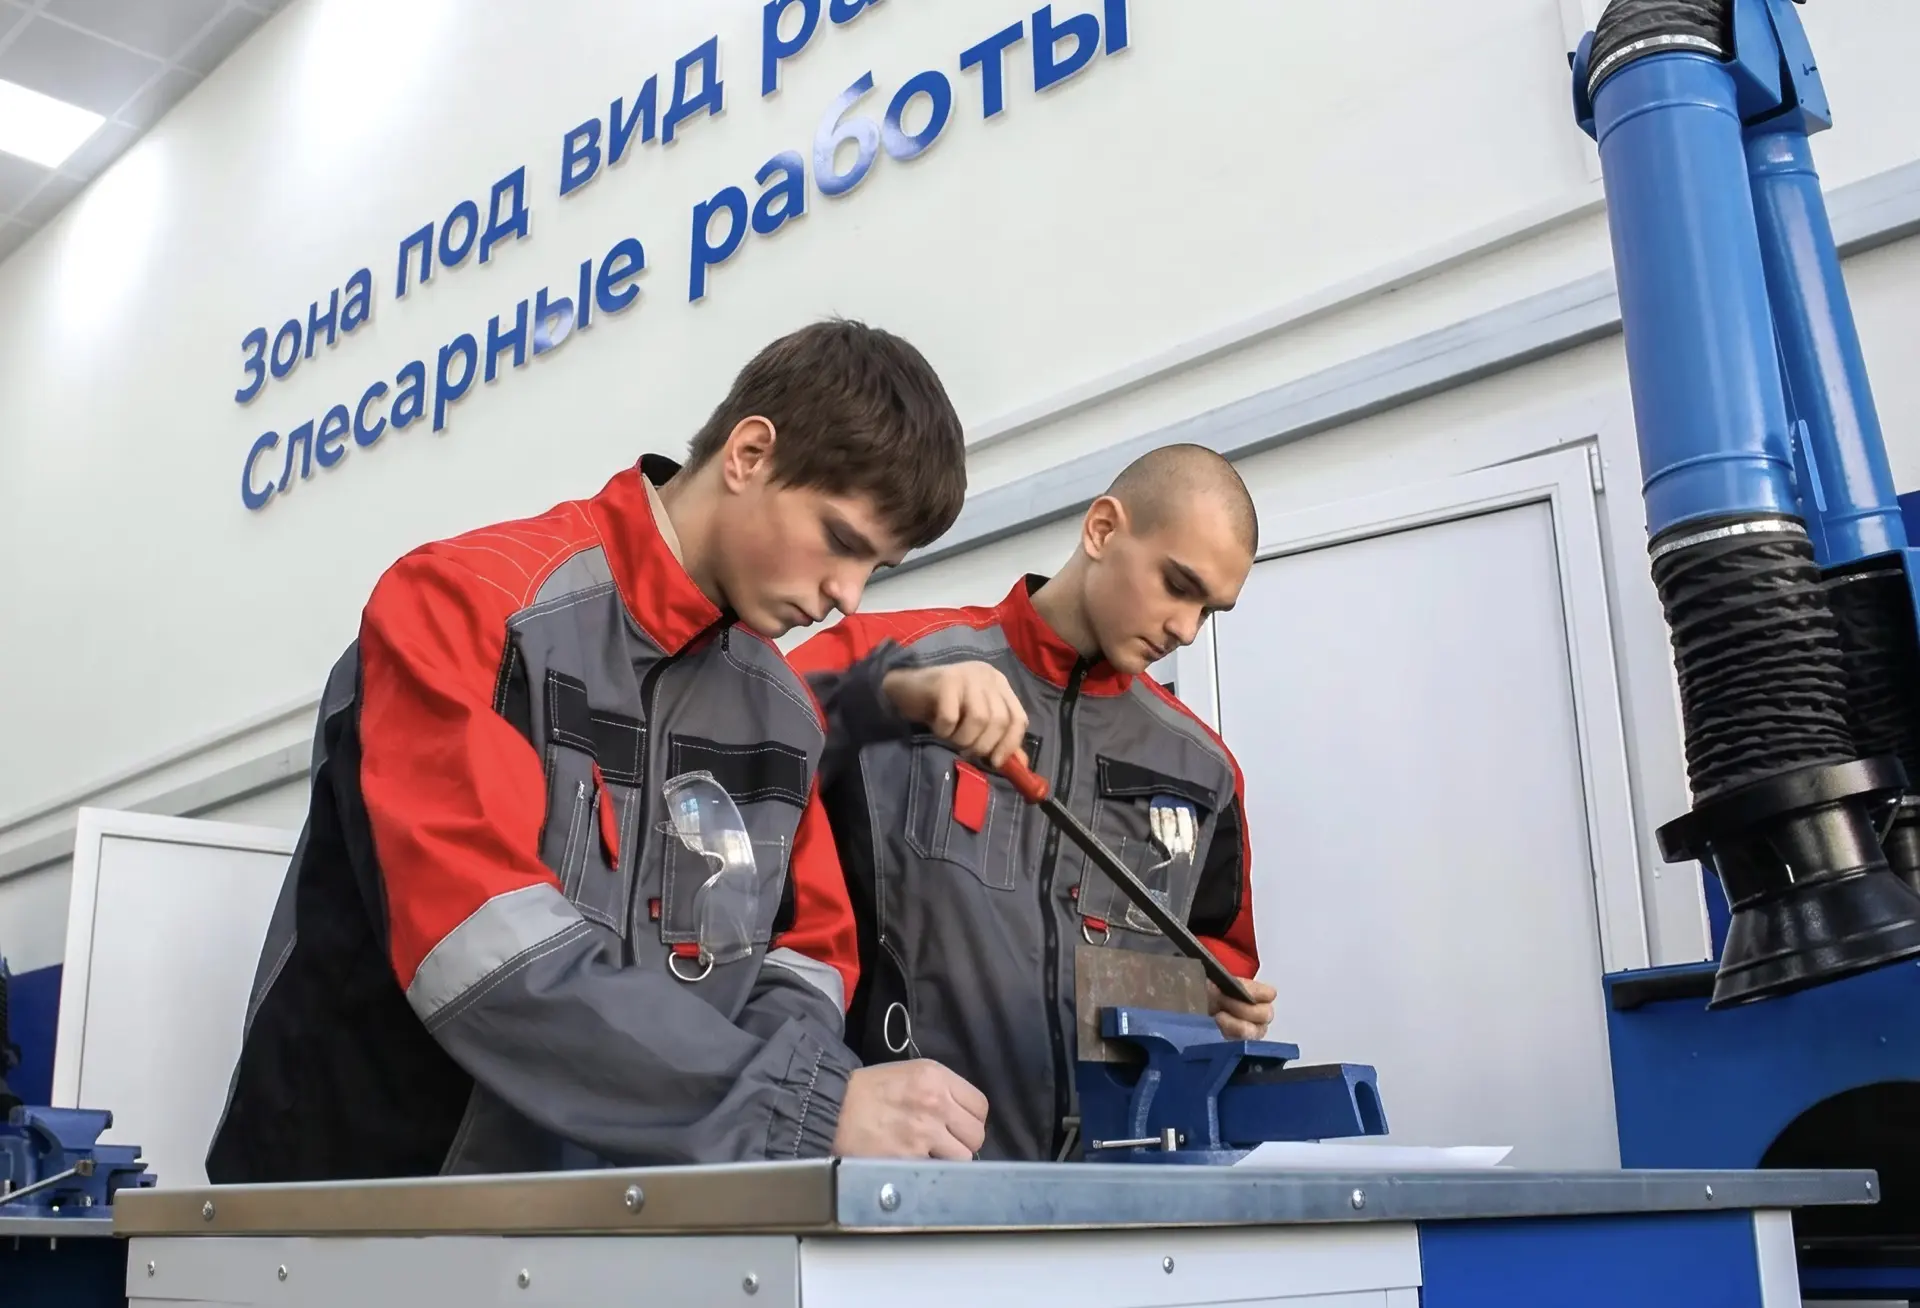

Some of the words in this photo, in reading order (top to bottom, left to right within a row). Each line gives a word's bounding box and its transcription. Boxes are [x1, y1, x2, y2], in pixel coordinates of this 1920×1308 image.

[235, 268, 373, 403] Зона
[396, 166, 530, 298] под
[559, 36, 725, 196] вид
[241, 237, 647, 510] Слесарные
[688, 0, 1129, 303] работы
